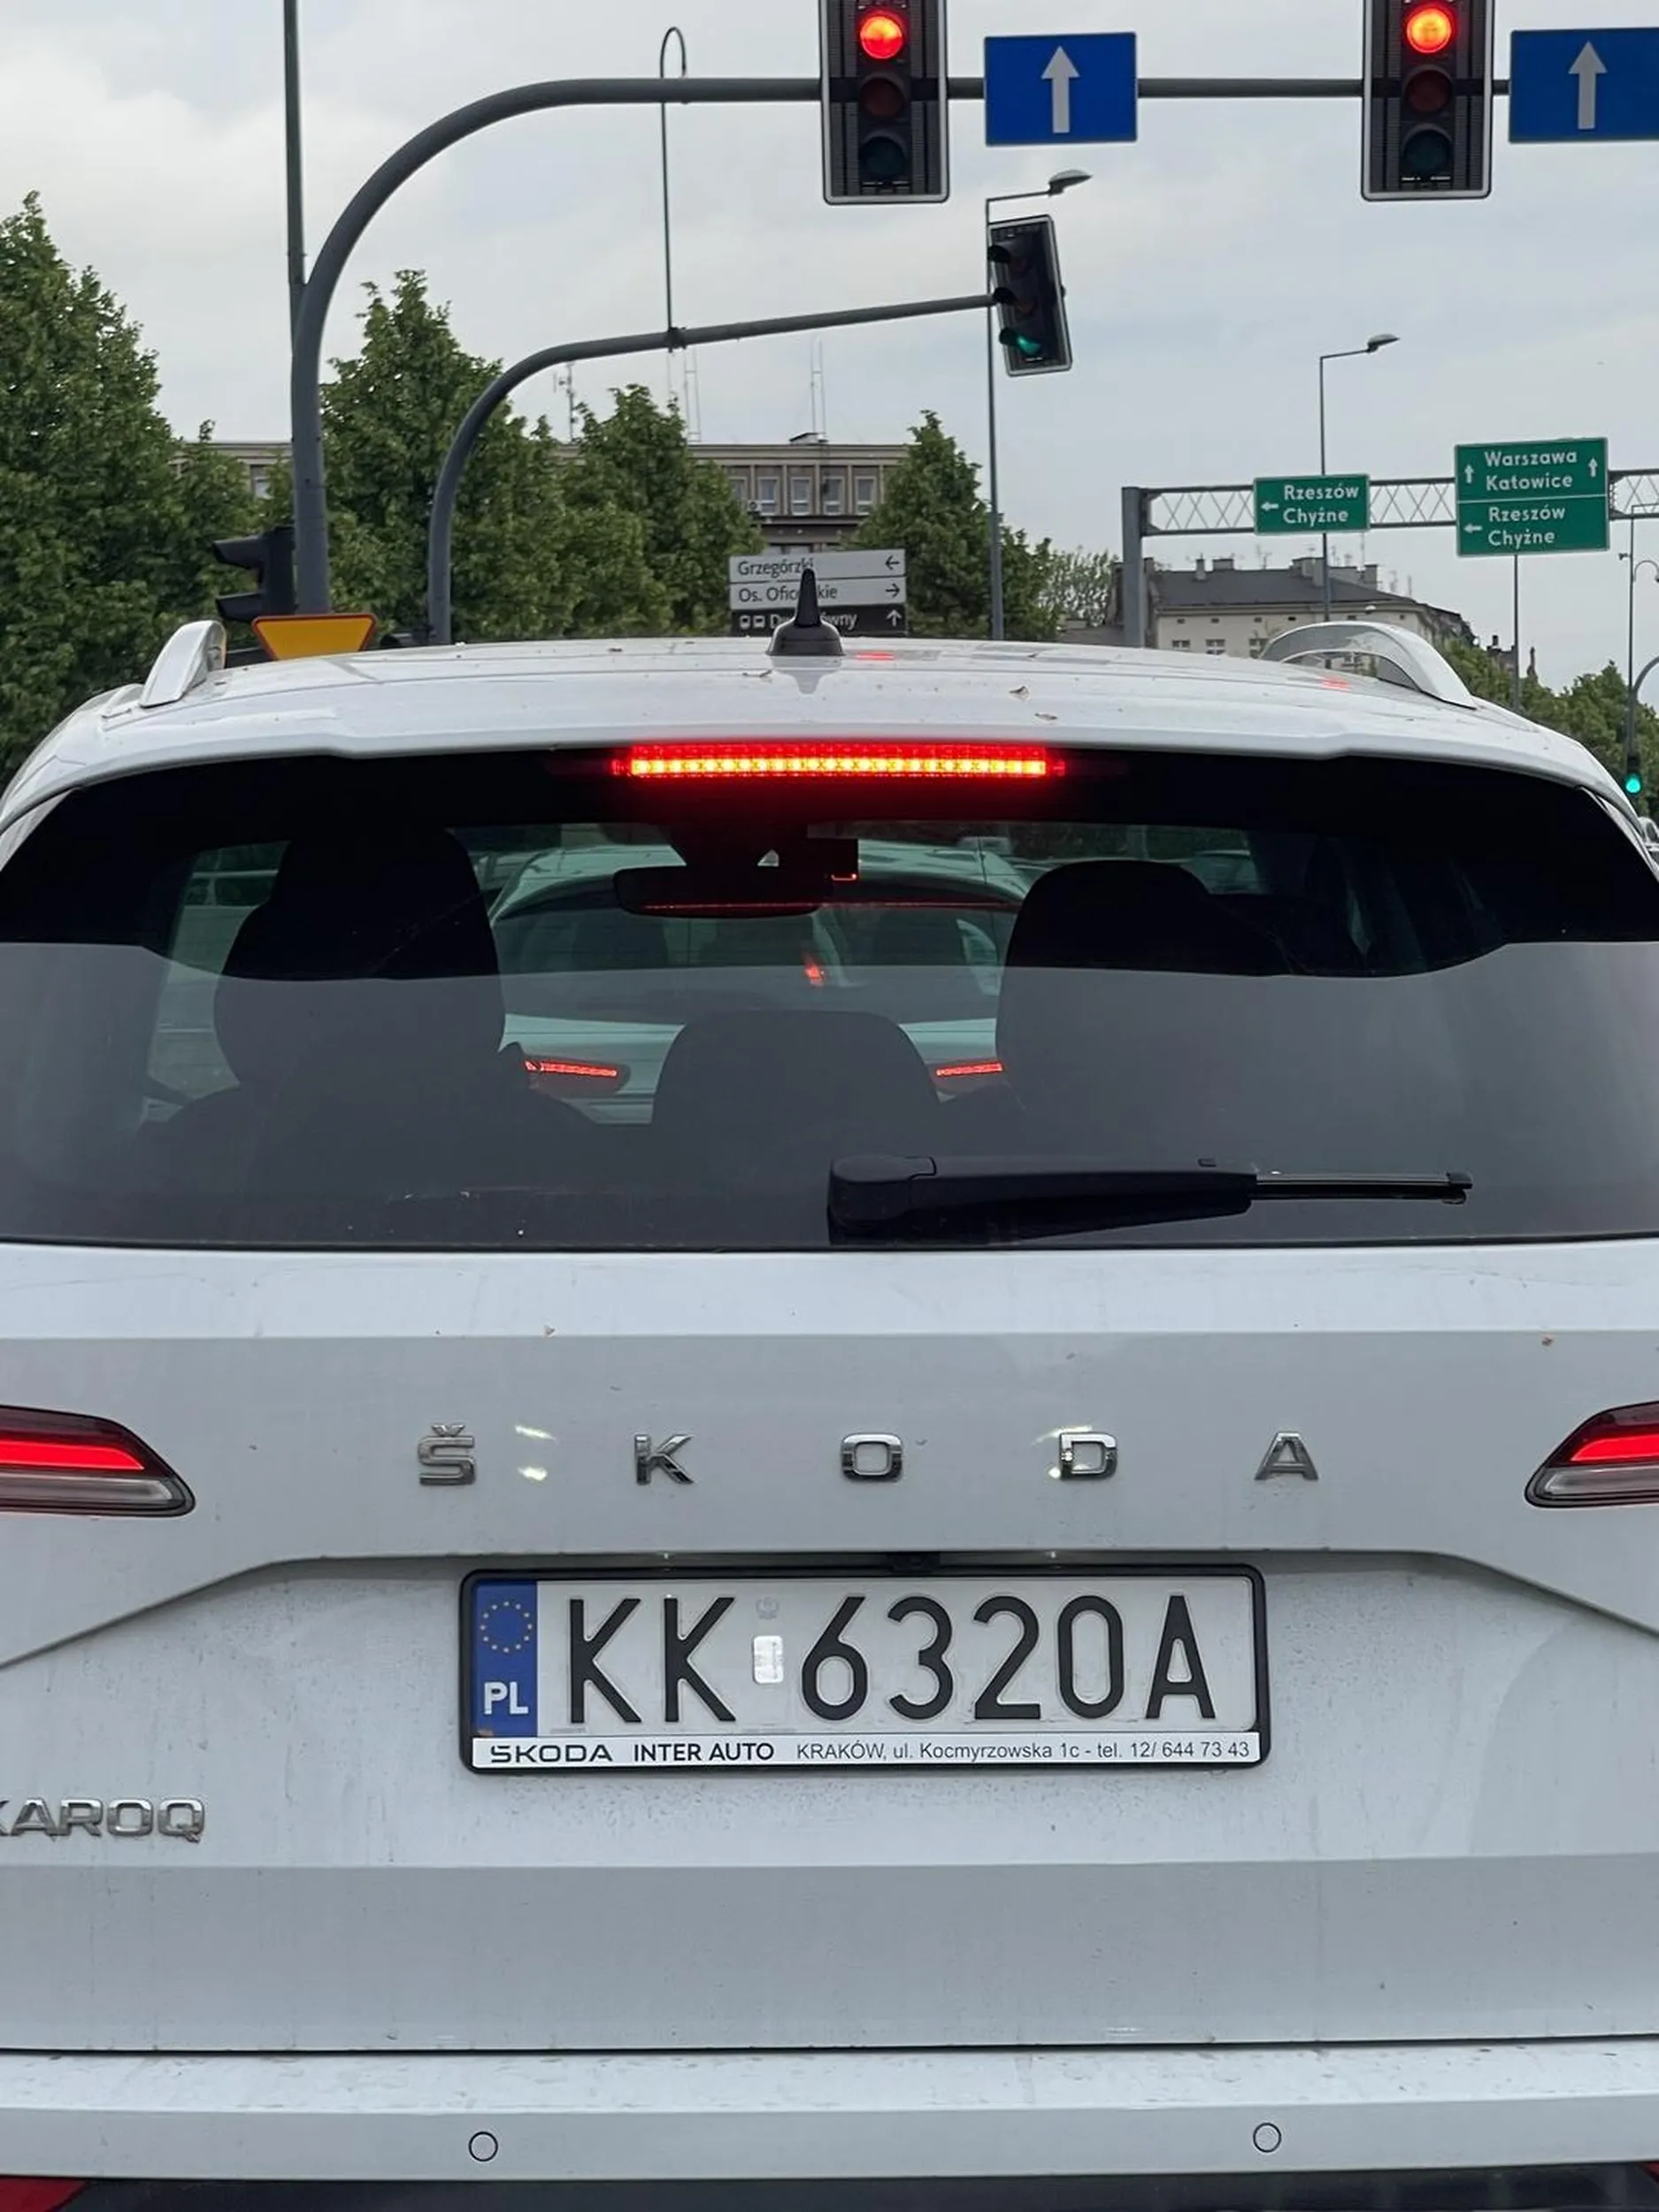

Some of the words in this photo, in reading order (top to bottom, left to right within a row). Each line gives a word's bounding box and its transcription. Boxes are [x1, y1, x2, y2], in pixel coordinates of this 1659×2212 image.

[1484, 451, 1578, 467] Warszawa
[1486, 472, 1573, 491] Katowice
[1284, 482, 1359, 501] Rzeszów
[1488, 504, 1565, 522] Rzeszów
[1488, 529, 1555, 549] Chyżne
[739, 588, 762, 603] Os.
[569, 1597, 736, 1723] KK
[802, 1595, 1216, 1721] 6320A
[484, 1682, 529, 1715] PL
[634, 1743, 702, 1761] INTER
[709, 1742, 774, 1760] AUTO
[797, 1740, 886, 1760] KRAKÓW,
[894, 1743, 913, 1758] ul.
[920, 1741, 1052, 1763] Kocmyrzowska
[1061, 1742, 1079, 1758] 1c
[1097, 1742, 1122, 1758] tel.
[1162, 1741, 1194, 1758] 644
[1200, 1741, 1222, 1758] 73
[1228, 1741, 1249, 1757] 43
[0, 1800, 205, 1843] AROQ
